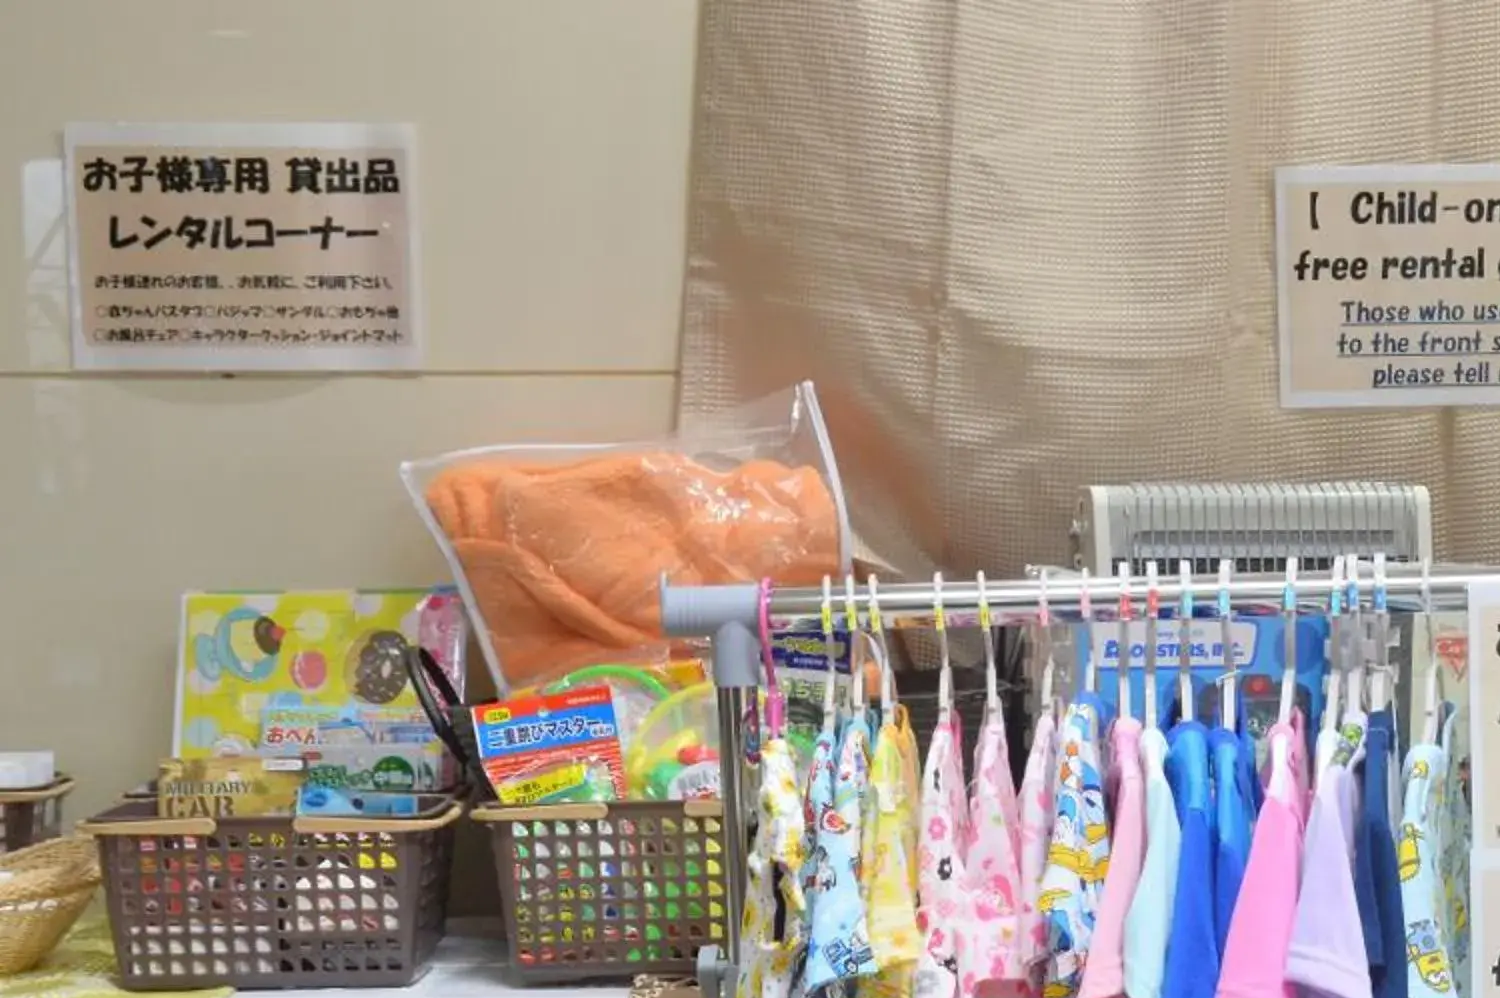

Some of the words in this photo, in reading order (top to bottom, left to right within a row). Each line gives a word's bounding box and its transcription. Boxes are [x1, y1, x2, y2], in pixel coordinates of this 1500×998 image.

[84, 157, 270, 193] お子様専用
[286, 157, 400, 193] 貸出品
[109, 215, 379, 250] レンタルコーナー
[1294, 250, 1367, 280] free
[1381, 247, 1484, 279] rental
[1341, 301, 1410, 323] Those
[1419, 300, 1464, 322] who
[1337, 333, 1362, 354] to
[1372, 332, 1409, 353] the
[1418, 331, 1482, 352] front
[1372, 364, 1445, 387] please
[1455, 363, 1489, 383] tell
